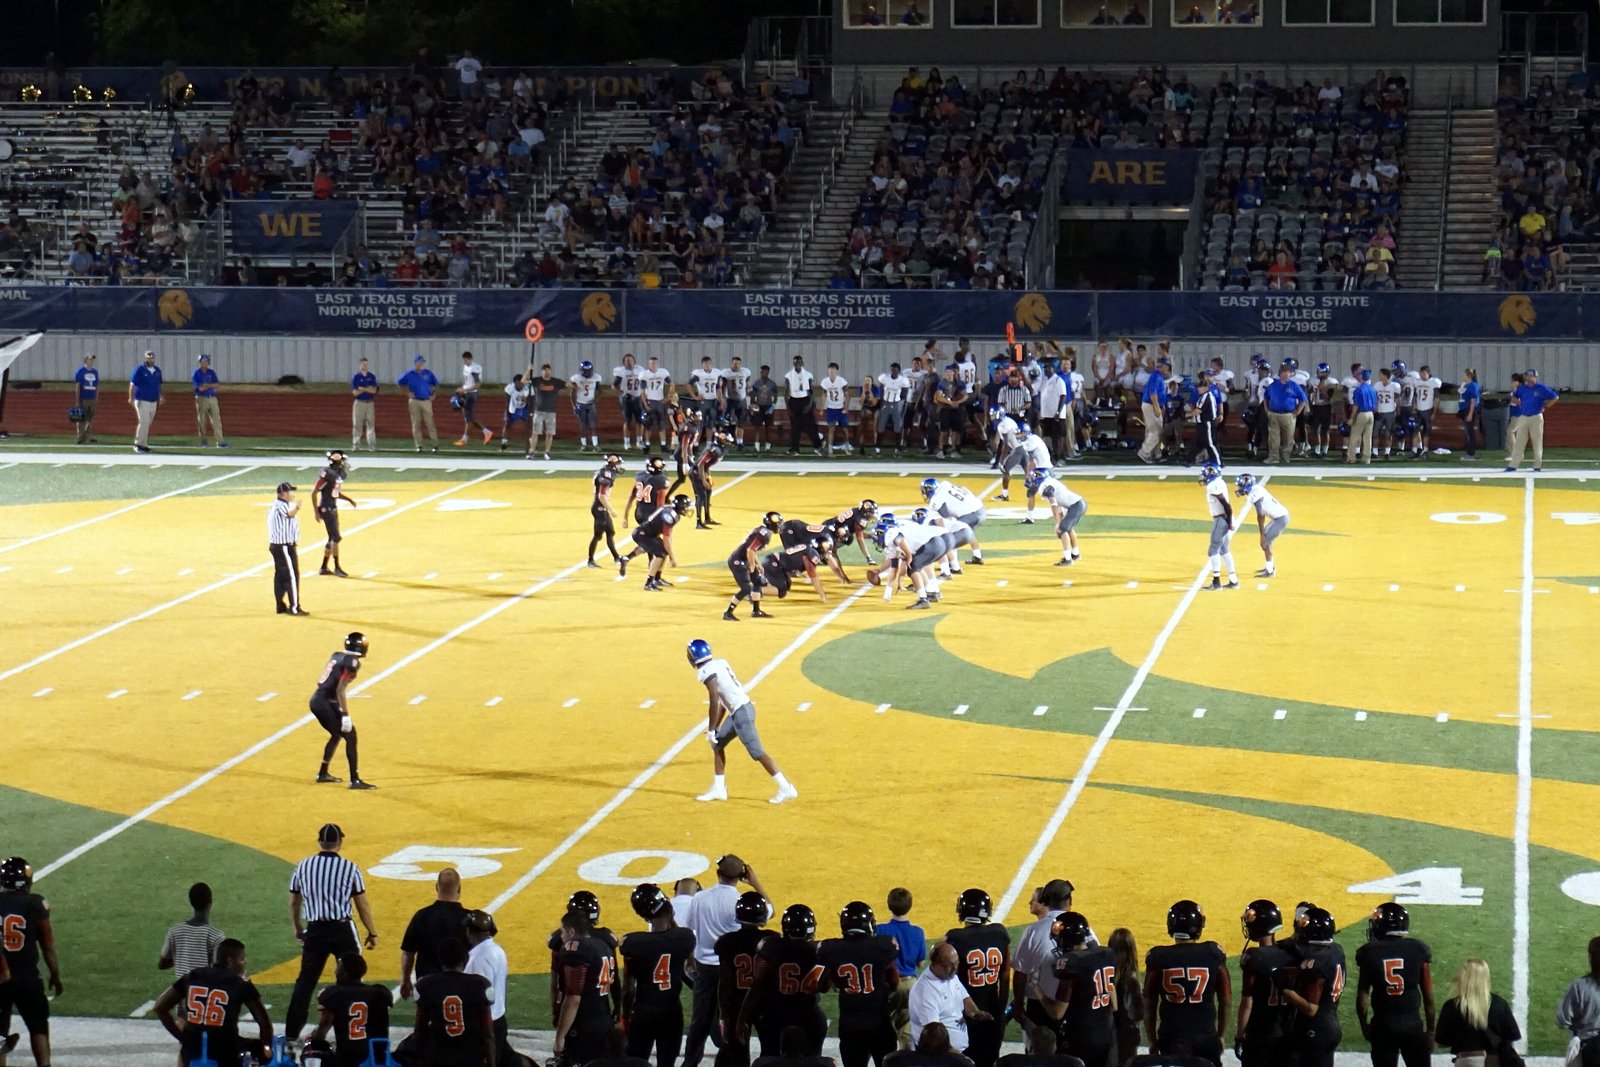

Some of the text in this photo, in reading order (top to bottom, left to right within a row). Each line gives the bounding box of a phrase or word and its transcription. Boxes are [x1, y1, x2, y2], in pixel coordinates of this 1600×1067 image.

[1089, 161, 1168, 185] ARE
[259, 212, 322, 236] WE
[315, 293, 457, 305] EAST TEXAS STATE
[745, 293, 891, 305] EAST TEXAS STATE
[1219, 296, 1370, 307] EAST TEXAS STATE
[318, 306, 454, 317] NORMAL COLLEGE
[356, 318, 416, 329] 1917-1923
[741, 306, 895, 317] TEACHERS COLLEGE
[786, 318, 851, 329] 1923-1957
[1261, 308, 1332, 320] COLLEGE
[1260, 321, 1328, 332] 1957-1962
[0, 914, 27, 952] 6
[653, 953, 672, 991] 4
[837, 962, 876, 995] 31
[966, 946, 1004, 988] 29
[1383, 957, 1405, 996] 5
[1091, 966, 1116, 1010] 15
[1162, 967, 1210, 1004] 57
[186, 985, 229, 1028] 56
[442, 995, 466, 1037] 9
[348, 1001, 369, 1041] 2
